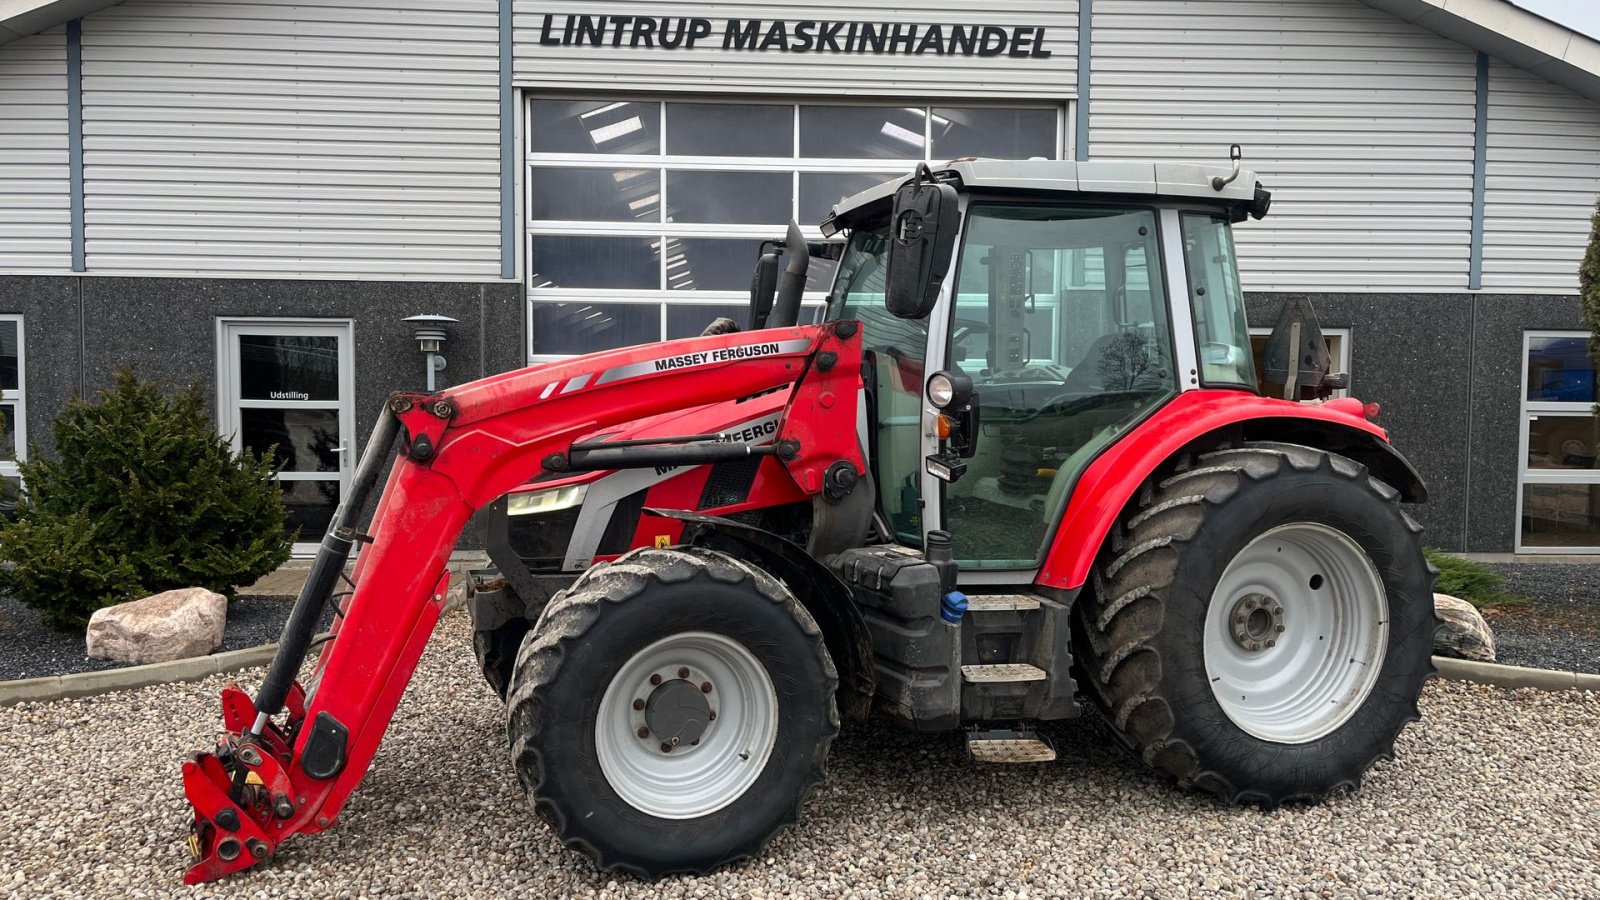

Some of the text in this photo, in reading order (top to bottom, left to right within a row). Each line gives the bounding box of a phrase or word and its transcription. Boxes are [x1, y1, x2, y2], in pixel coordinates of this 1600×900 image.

[540, 14, 1052, 58] LINTRUP MASKINHANDEL
[655, 343, 779, 371] MASSEY FERGUSON
[270, 391, 309, 401] Udstilling
